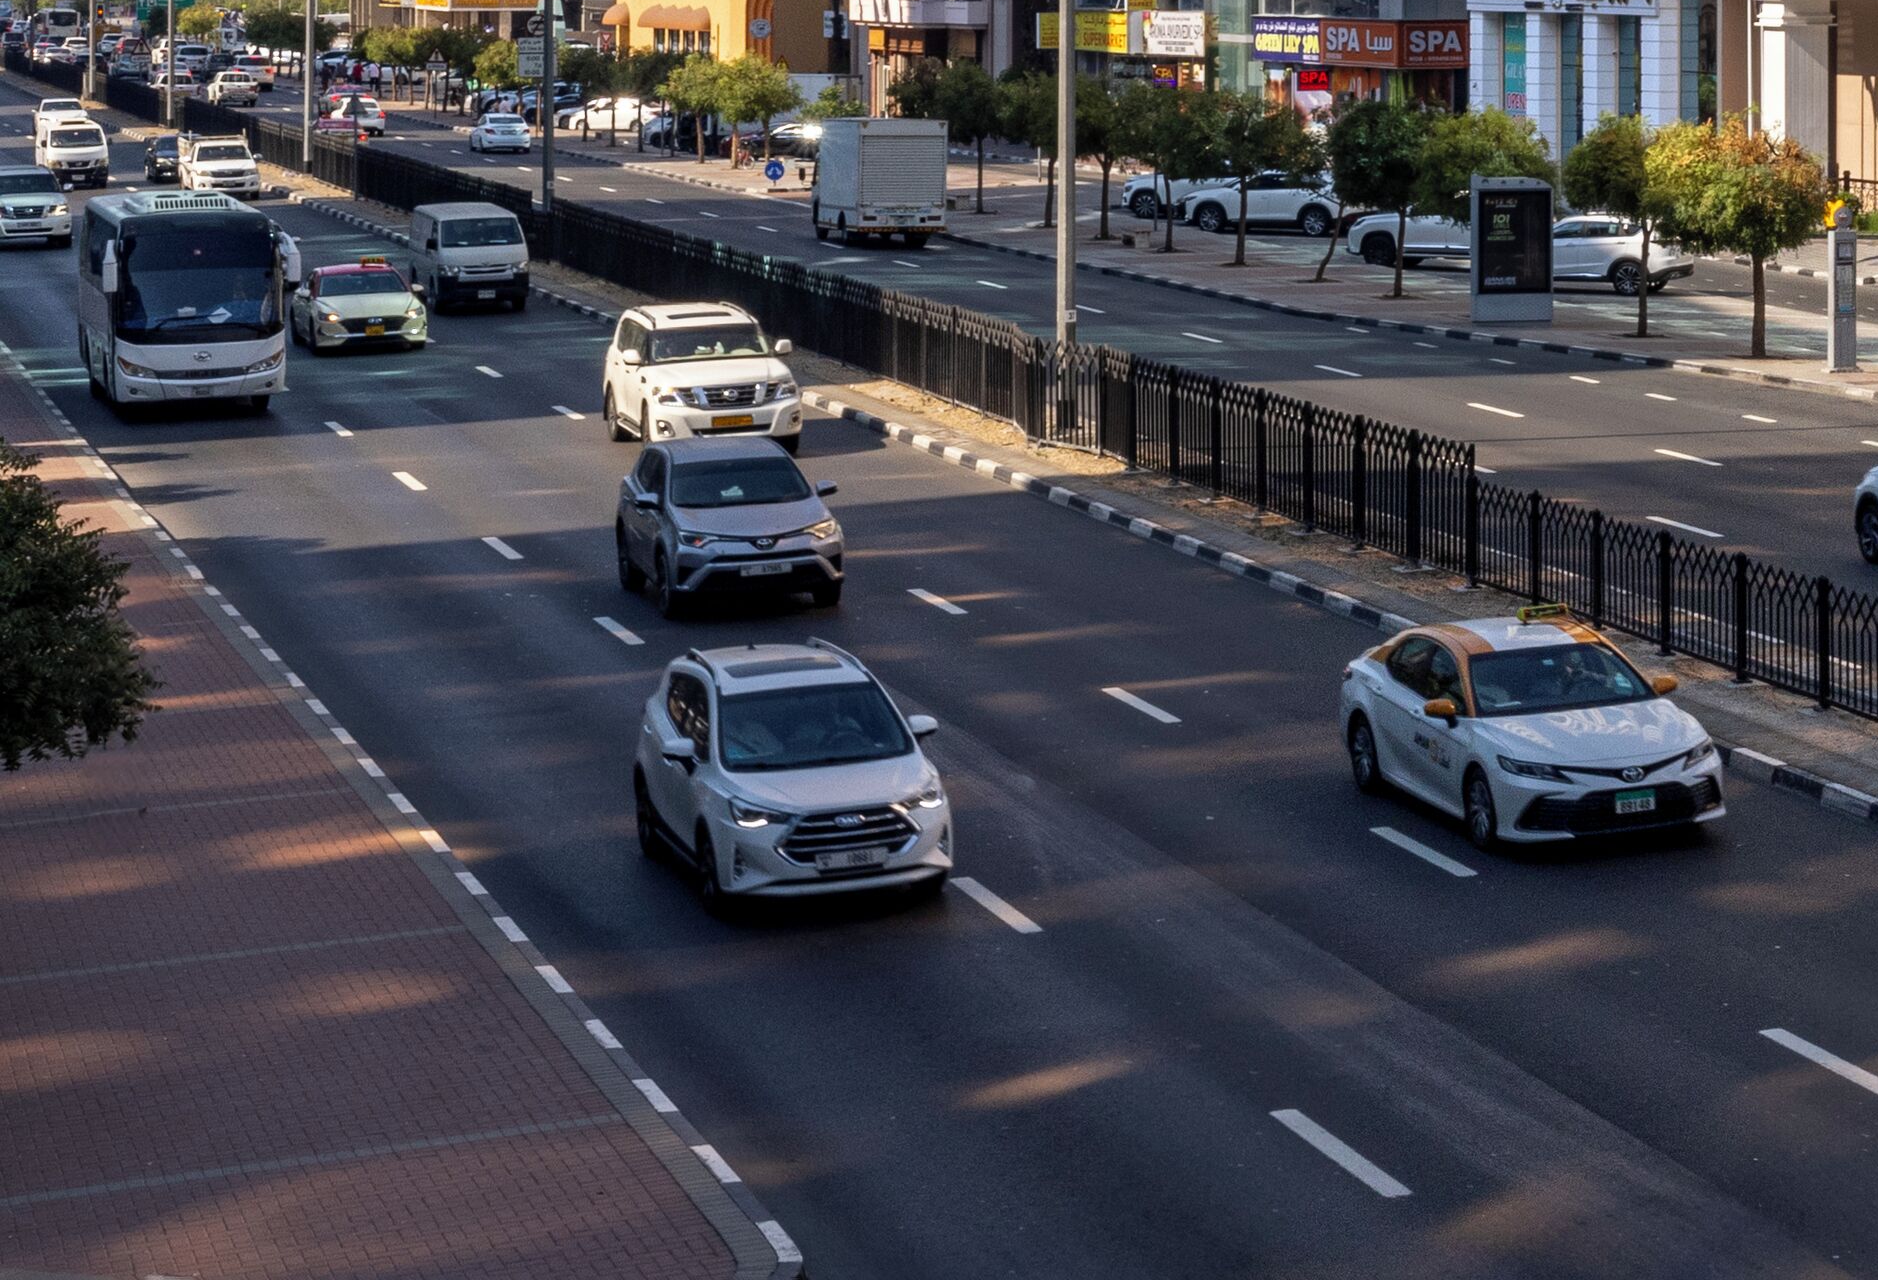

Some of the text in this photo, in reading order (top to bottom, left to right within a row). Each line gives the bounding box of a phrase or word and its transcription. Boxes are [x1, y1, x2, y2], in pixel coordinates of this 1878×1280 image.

[1083, 32, 1127, 48] SUPERMARKET
[1302, 34, 1321, 54] SPA
[1326, 26, 1360, 52] SPA
[1408, 30, 1463, 53] SPA
[1301, 71, 1329, 85] SPA
[1493, 214, 1510, 224] 101
